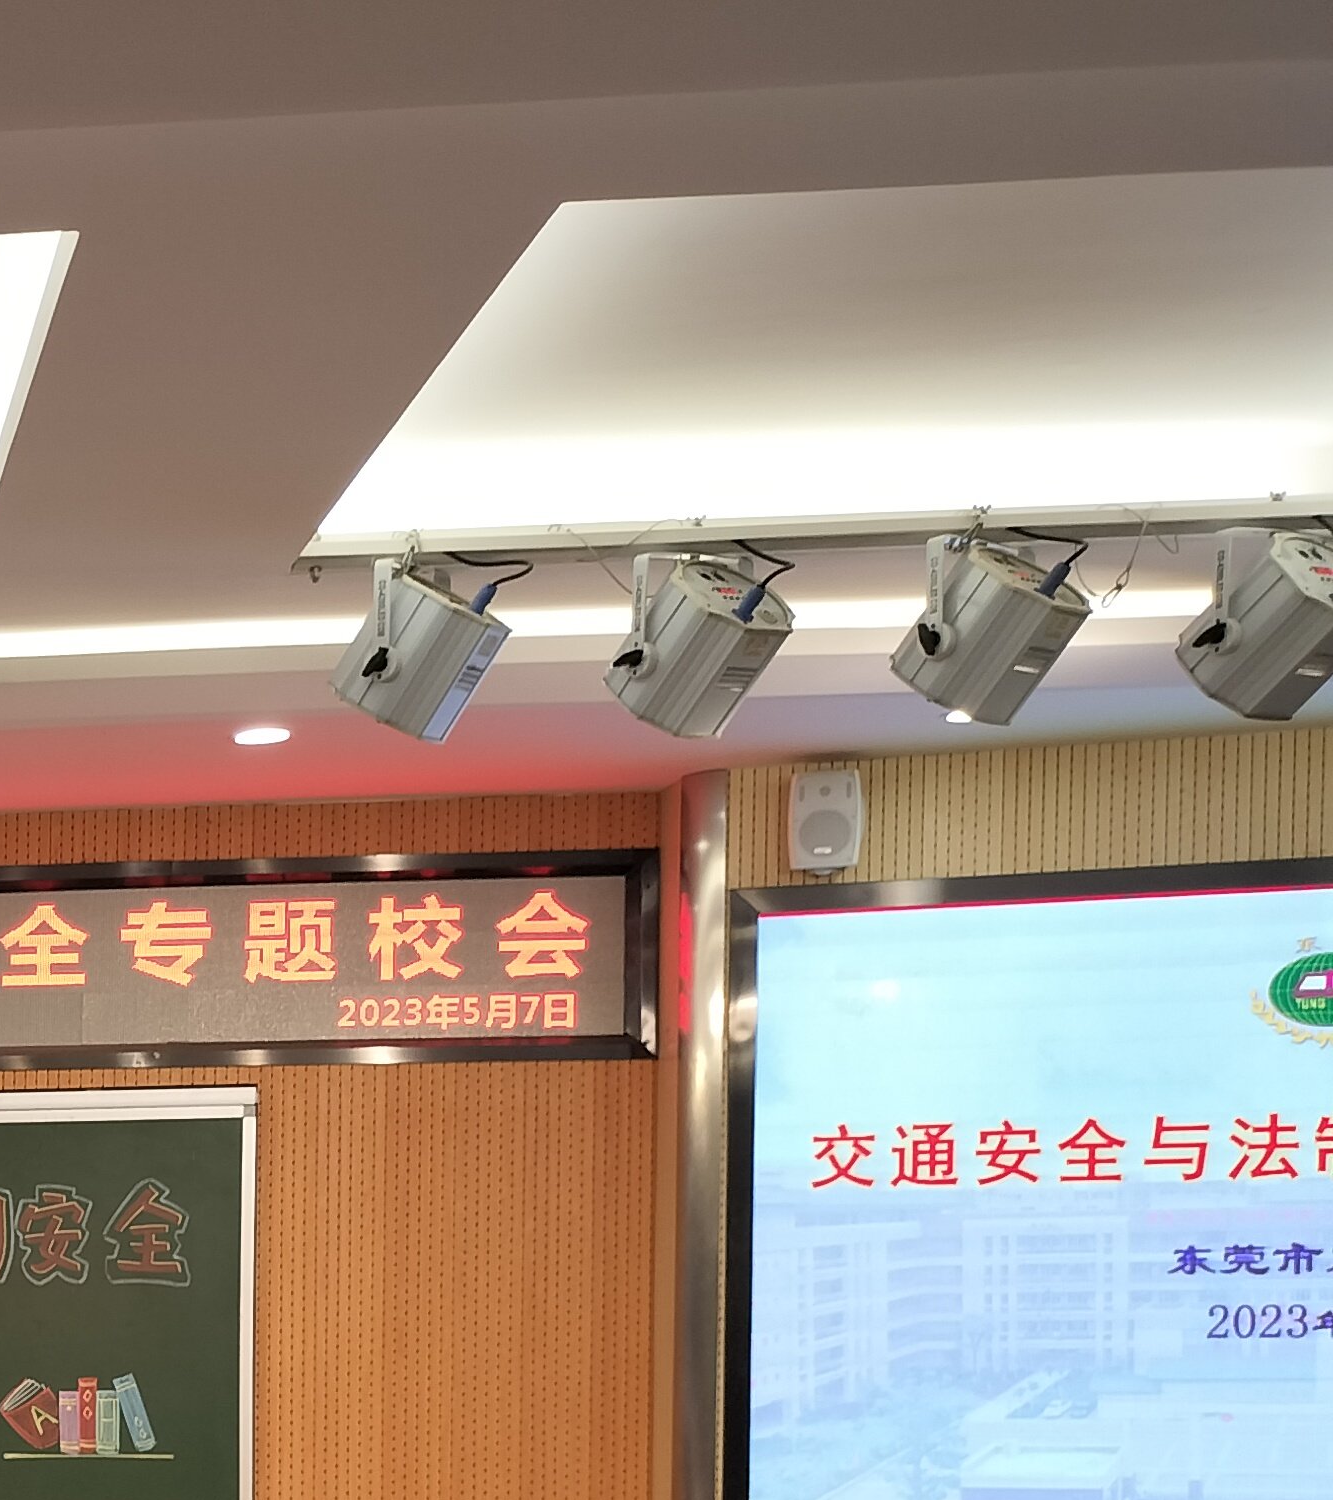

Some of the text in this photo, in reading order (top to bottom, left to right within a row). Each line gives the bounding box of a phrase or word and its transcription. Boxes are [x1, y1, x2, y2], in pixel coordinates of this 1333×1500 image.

[336, 993, 578, 1030] 2023年5月7日
[810, 1112, 1333, 1188] 交通安全与法
[1168, 1242, 1333, 1276] 东莞市
